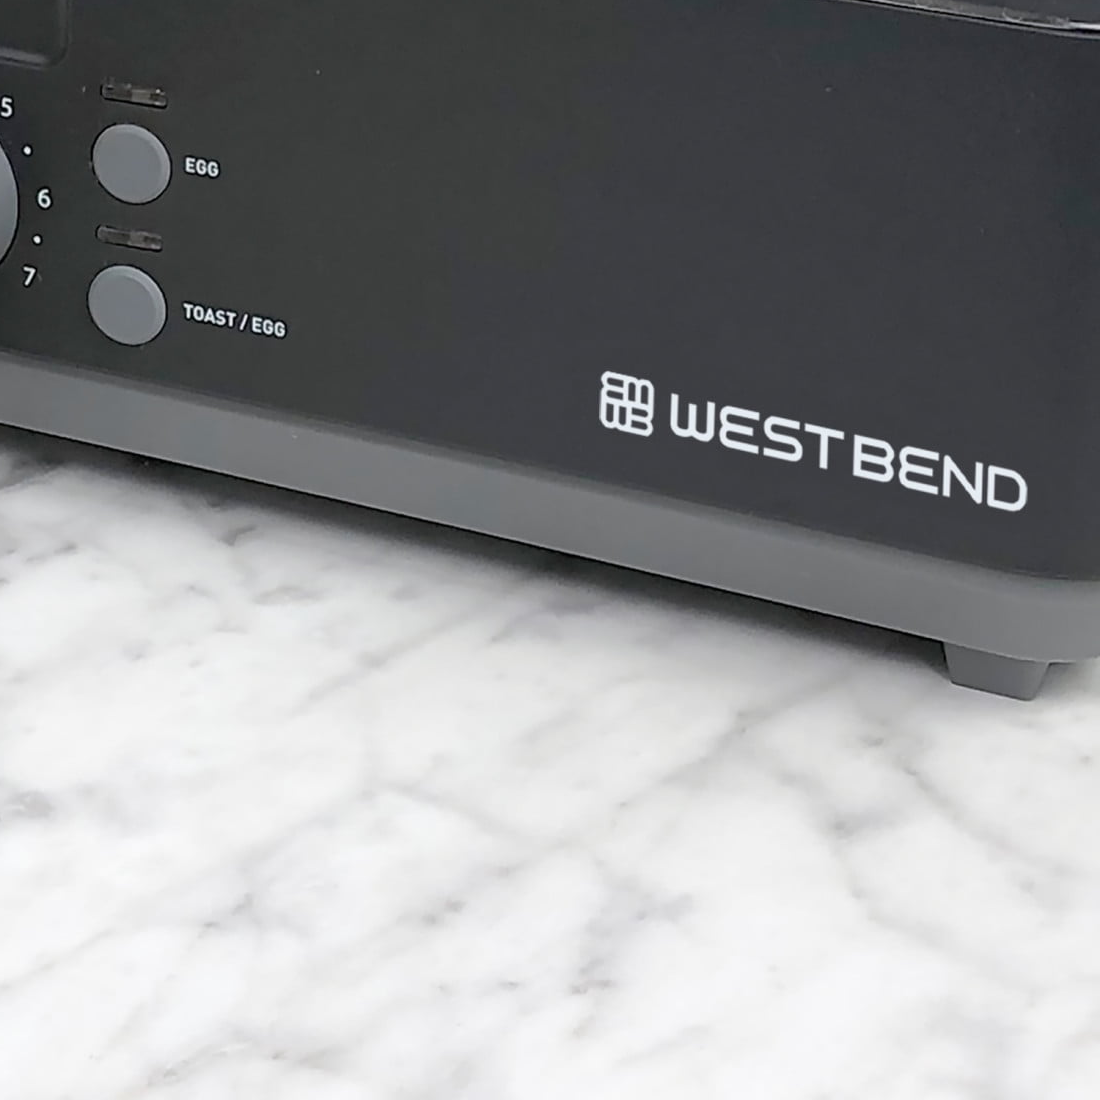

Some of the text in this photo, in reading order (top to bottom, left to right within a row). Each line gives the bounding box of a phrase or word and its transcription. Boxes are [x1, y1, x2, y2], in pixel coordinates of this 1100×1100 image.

[0, 97, 13, 117] 5
[185, 157, 219, 177] EGG
[37, 189, 51, 209] 6
[23, 266, 36, 286] 7
[183, 303, 237, 327] TOAST
[251, 316, 286, 337] EGG
[669, 392, 1028, 512] WEST BEND
